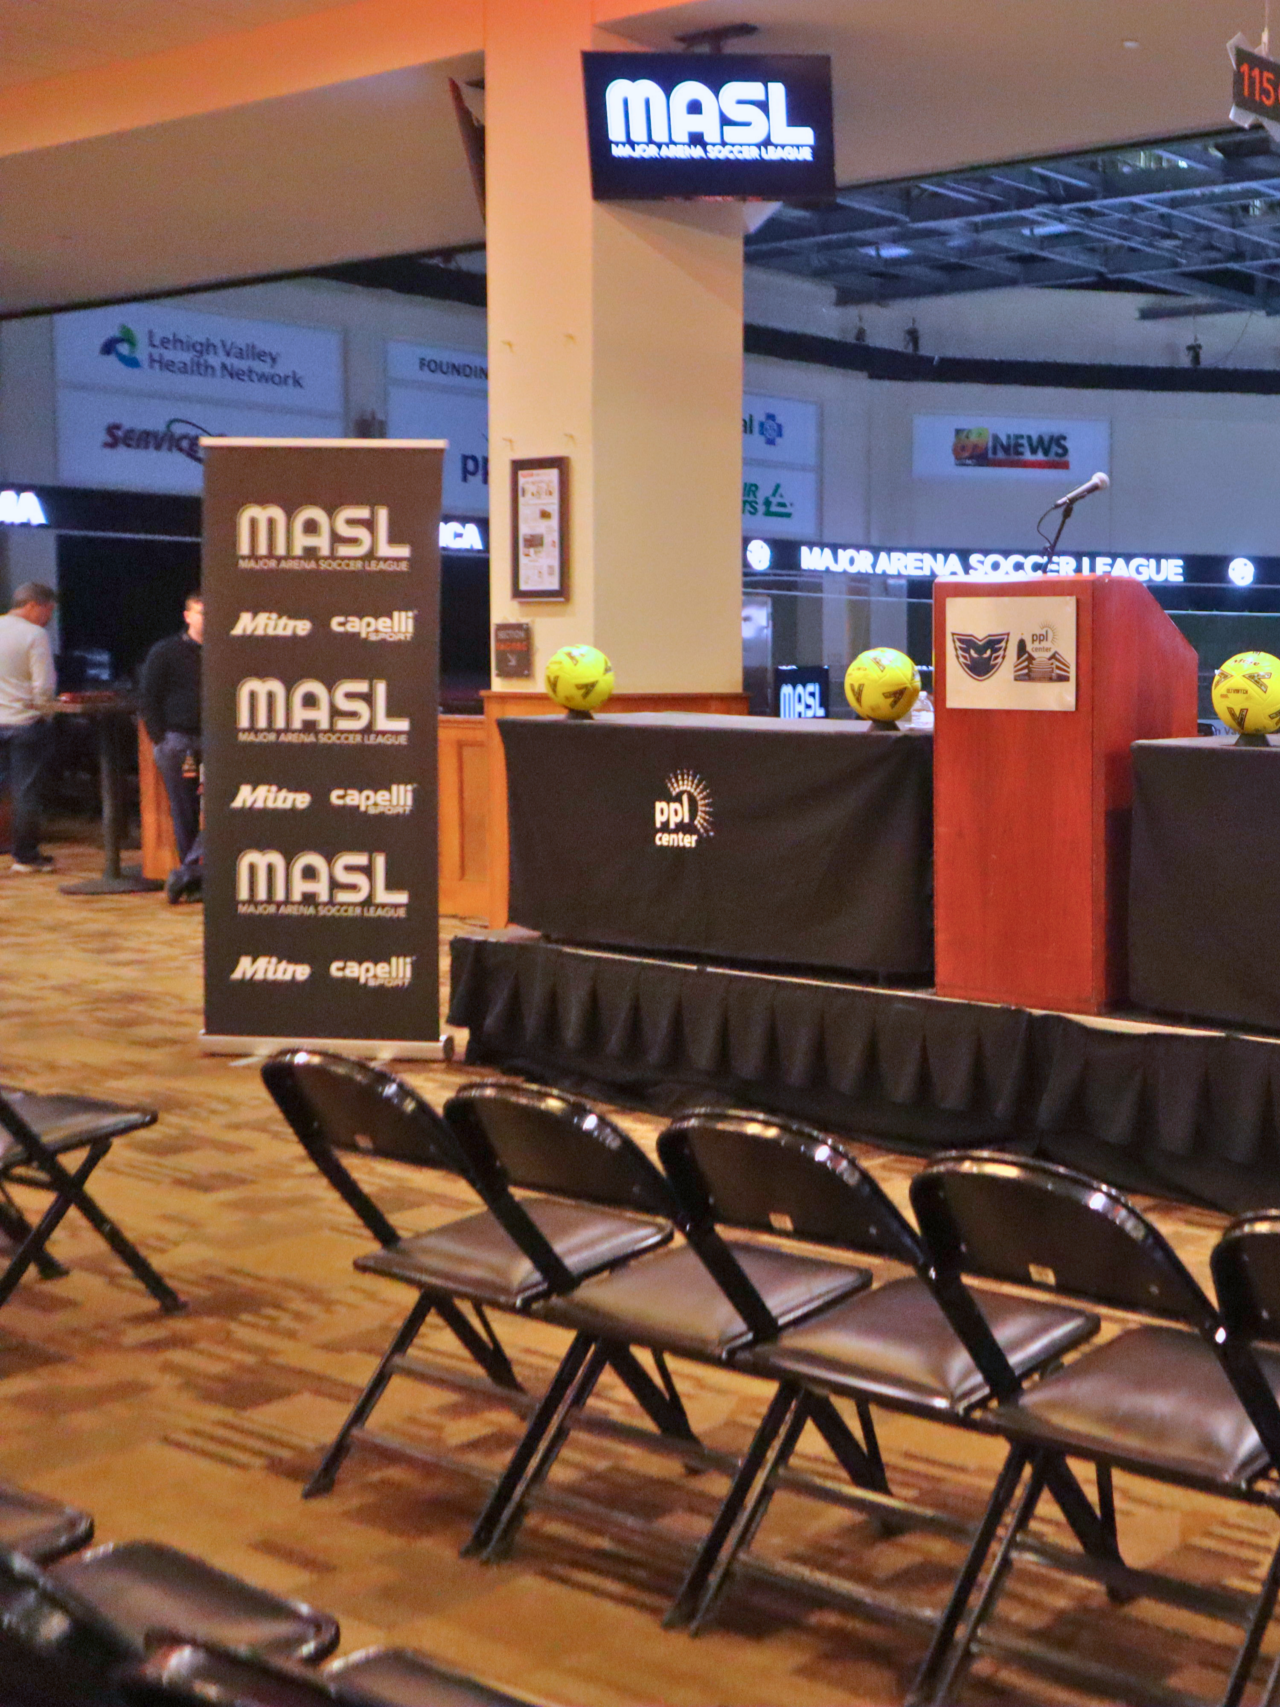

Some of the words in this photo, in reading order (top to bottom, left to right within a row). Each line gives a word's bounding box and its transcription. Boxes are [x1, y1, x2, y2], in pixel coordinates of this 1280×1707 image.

[605, 79, 815, 145] MASL
[611, 144, 660, 159] MAJOR
[660, 145, 707, 160] ARENA
[707, 145, 760, 161] SOCCER
[761, 146, 814, 162] LEAGUE
[147, 329, 217, 357] Lehigh
[219, 339, 281, 367] Valley
[147, 351, 217, 379] Health
[220, 361, 304, 389] Network
[990, 432, 1070, 459] NEWS
[237, 503, 411, 558] MASL
[238, 558, 278, 570] MAJOR
[279, 559, 318, 570] ARENA
[318, 559, 364, 571] SOCCER
[365, 560, 410, 572] LEAGUE
[800, 546, 875, 575] MAJOR
[875, 551, 965, 577] ARENA
[230, 611, 313, 636] Mitre
[330, 610, 415, 638] capelli
[1031, 629, 1049, 645] ppl
[1030, 645, 1052, 653] center
[236, 677, 410, 731] MASL
[780, 682, 825, 719] MASL
[238, 731, 277, 743] MAJOR
[278, 732, 317, 743] ARENA
[318, 733, 363, 744] SOCCER
[364, 733, 409, 745] LEAGUE
[230, 784, 312, 809] Mitre
[330, 783, 414, 811] capelli
[655, 792, 690, 829] ppl
[655, 831, 698, 848] center
[236, 849, 409, 904] MASL
[237, 904, 277, 915] MAJOR
[278, 904, 317, 916] ARENA
[317, 905, 363, 917] SOCCER
[364, 906, 407, 918] LEAGUE
[230, 955, 312, 980] Mitre
[330, 955, 413, 985] capelli
